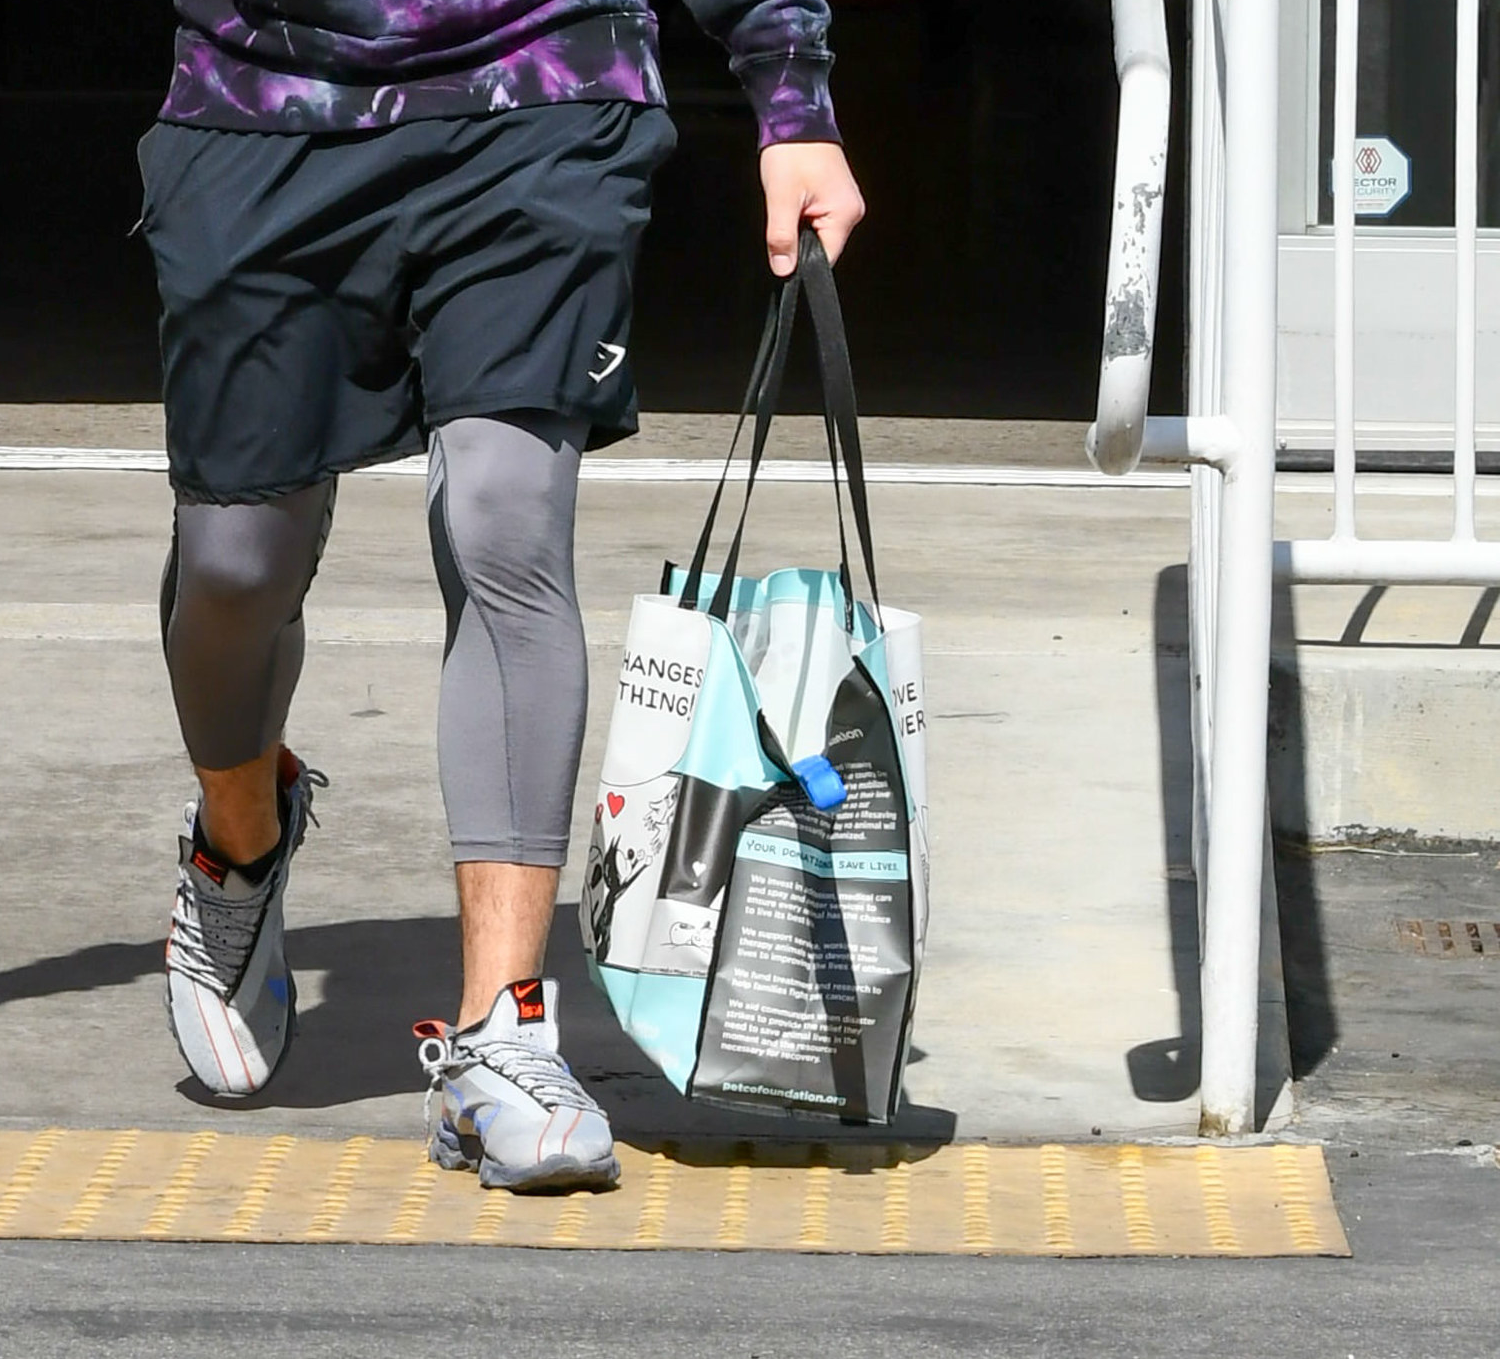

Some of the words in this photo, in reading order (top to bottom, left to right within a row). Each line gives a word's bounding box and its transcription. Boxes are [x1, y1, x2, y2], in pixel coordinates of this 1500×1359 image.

[619, 681, 695, 721] THING!
[746, 840, 776, 855] YOUR
[838, 860, 865, 870] SAVE
[748, 886, 766, 896] and
[767, 889, 789, 901] spay
[790, 893, 807, 904] and
[866, 903, 878, 912] to
[751, 874, 766, 885] We
[767, 876, 793, 890] invest
[838, 892, 874, 902] medical
[744, 906, 755, 915] to
[756, 907, 773, 918] live
[774, 910, 786, 920] its
[786, 912, 805, 925] best
[746, 896, 777, 908] ensure
[777, 902, 802, 914] every
[860, 914, 892, 925] chance
[739, 937, 774, 952] therapy
[741, 925, 757, 937] We
[758, 930, 793, 943] support
[860, 945, 878, 954] and
[737, 947, 758, 959] lives
[759, 951, 770, 959] to
[731, 978, 752, 990] help
[753, 982, 788, 995] families
[734, 967, 750, 979] We
[751, 971, 772, 982] fund
[872, 986, 883, 995] to
[728, 998, 744, 1009] We
[745, 1002, 760, 1012] aid
[724, 1021, 748, 1032] need
[748, 1024, 759, 1033] to
[760, 1027, 781, 1037] save
[781, 1031, 812, 1040] animal
[726, 1010, 756, 1022] strikes
[757, 1014, 768, 1024] to
[768, 1017, 802, 1030] provide
[722, 1032, 760, 1044] moment
[760, 1038, 779, 1048] and
[779, 1039, 795, 1050] the
[720, 1043, 765, 1057] necessary
[766, 1048, 780, 1058] for
[780, 1051, 822, 1065] recovery.
[722, 1081, 847, 1106] petcofoundation.org
